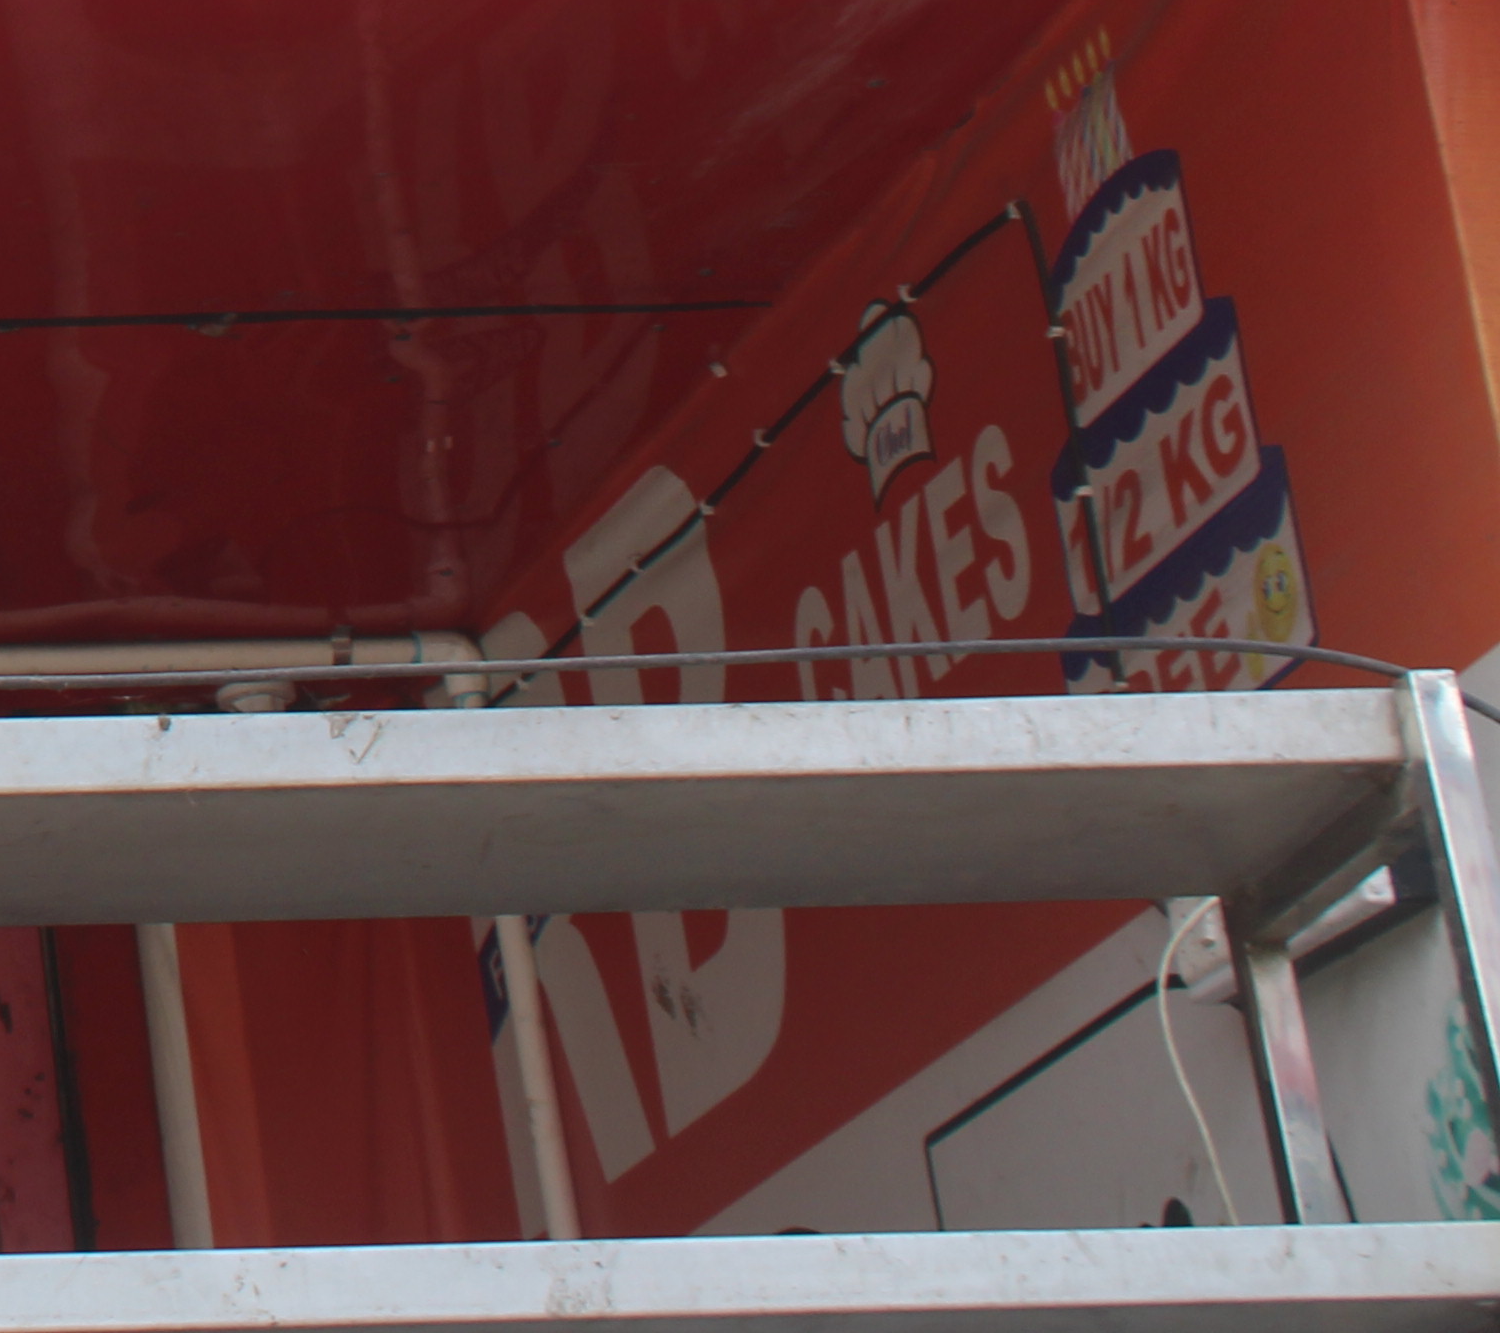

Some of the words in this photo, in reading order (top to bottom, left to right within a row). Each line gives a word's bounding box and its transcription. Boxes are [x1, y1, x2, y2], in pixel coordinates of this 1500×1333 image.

[1060, 272, 1120, 405] BUY
[1123, 251, 1145, 348] 1
[1142, 208, 1191, 330] KG
[1159, 374, 1246, 527] KG
